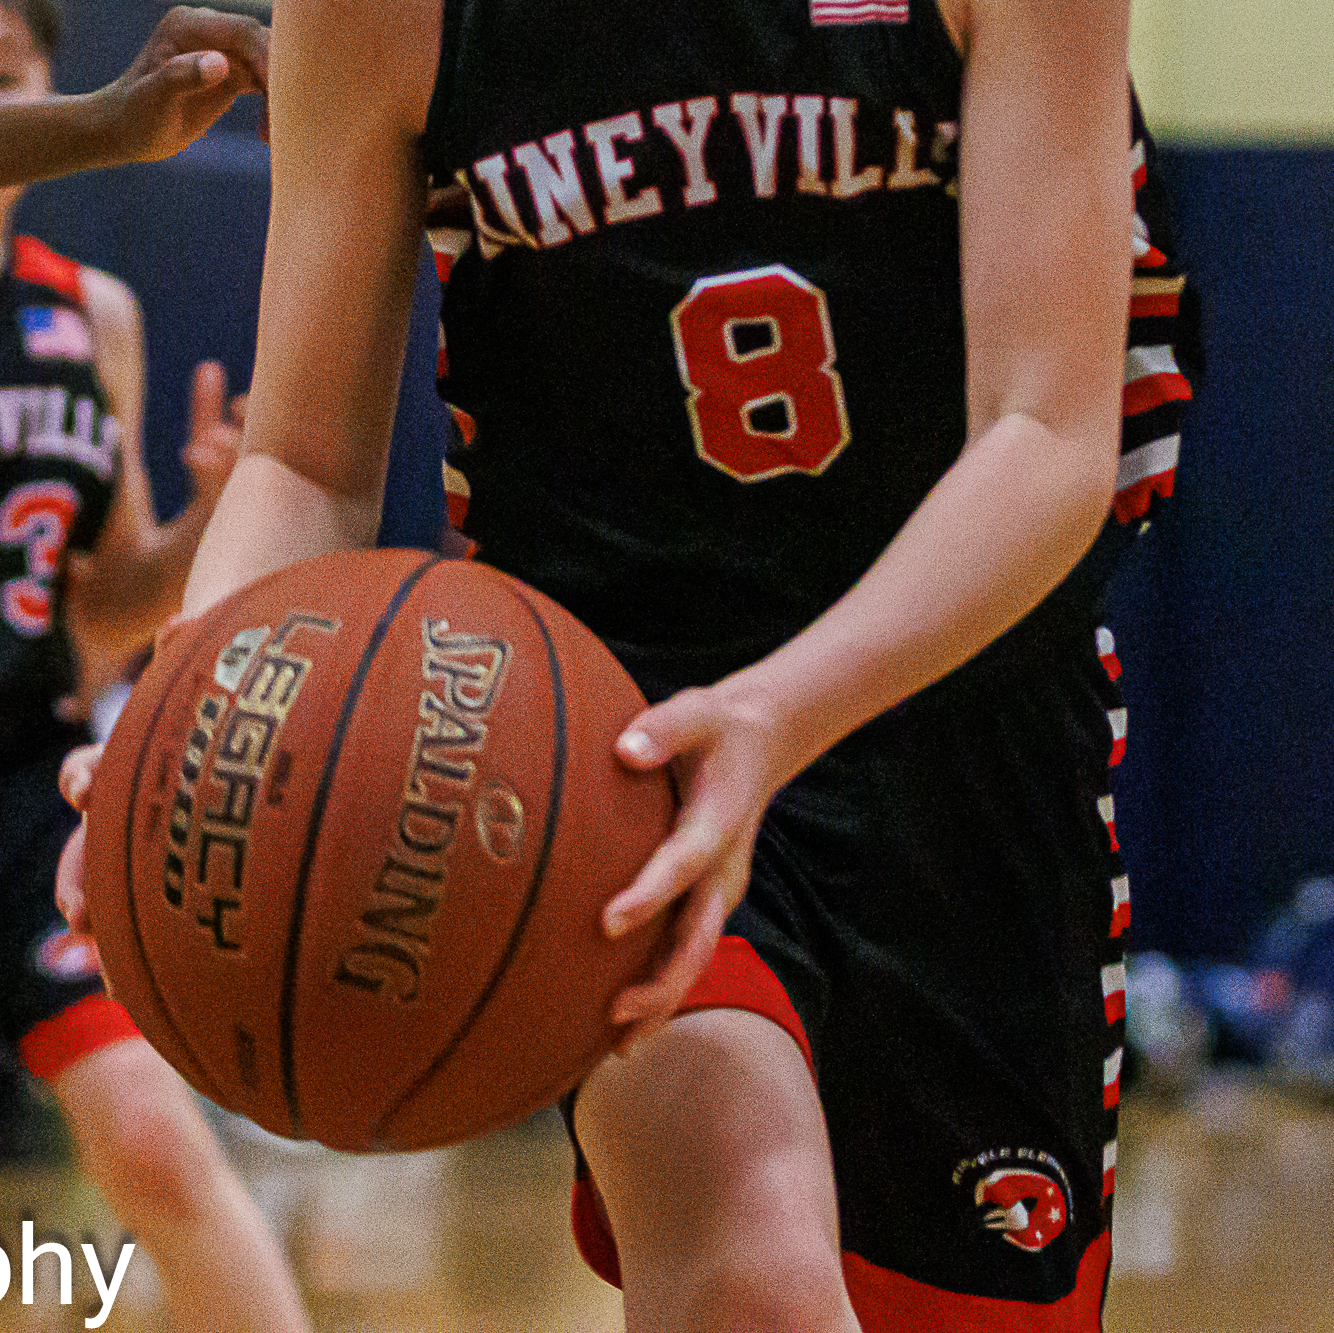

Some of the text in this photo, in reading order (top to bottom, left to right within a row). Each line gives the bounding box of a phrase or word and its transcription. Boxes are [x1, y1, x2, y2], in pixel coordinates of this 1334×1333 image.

[457, 91, 965, 260] INEYVILL
[669, 263, 851, 484] 8
[195, 611, 343, 956] LEGACY
[332, 616, 515, 1004] SPALDING
